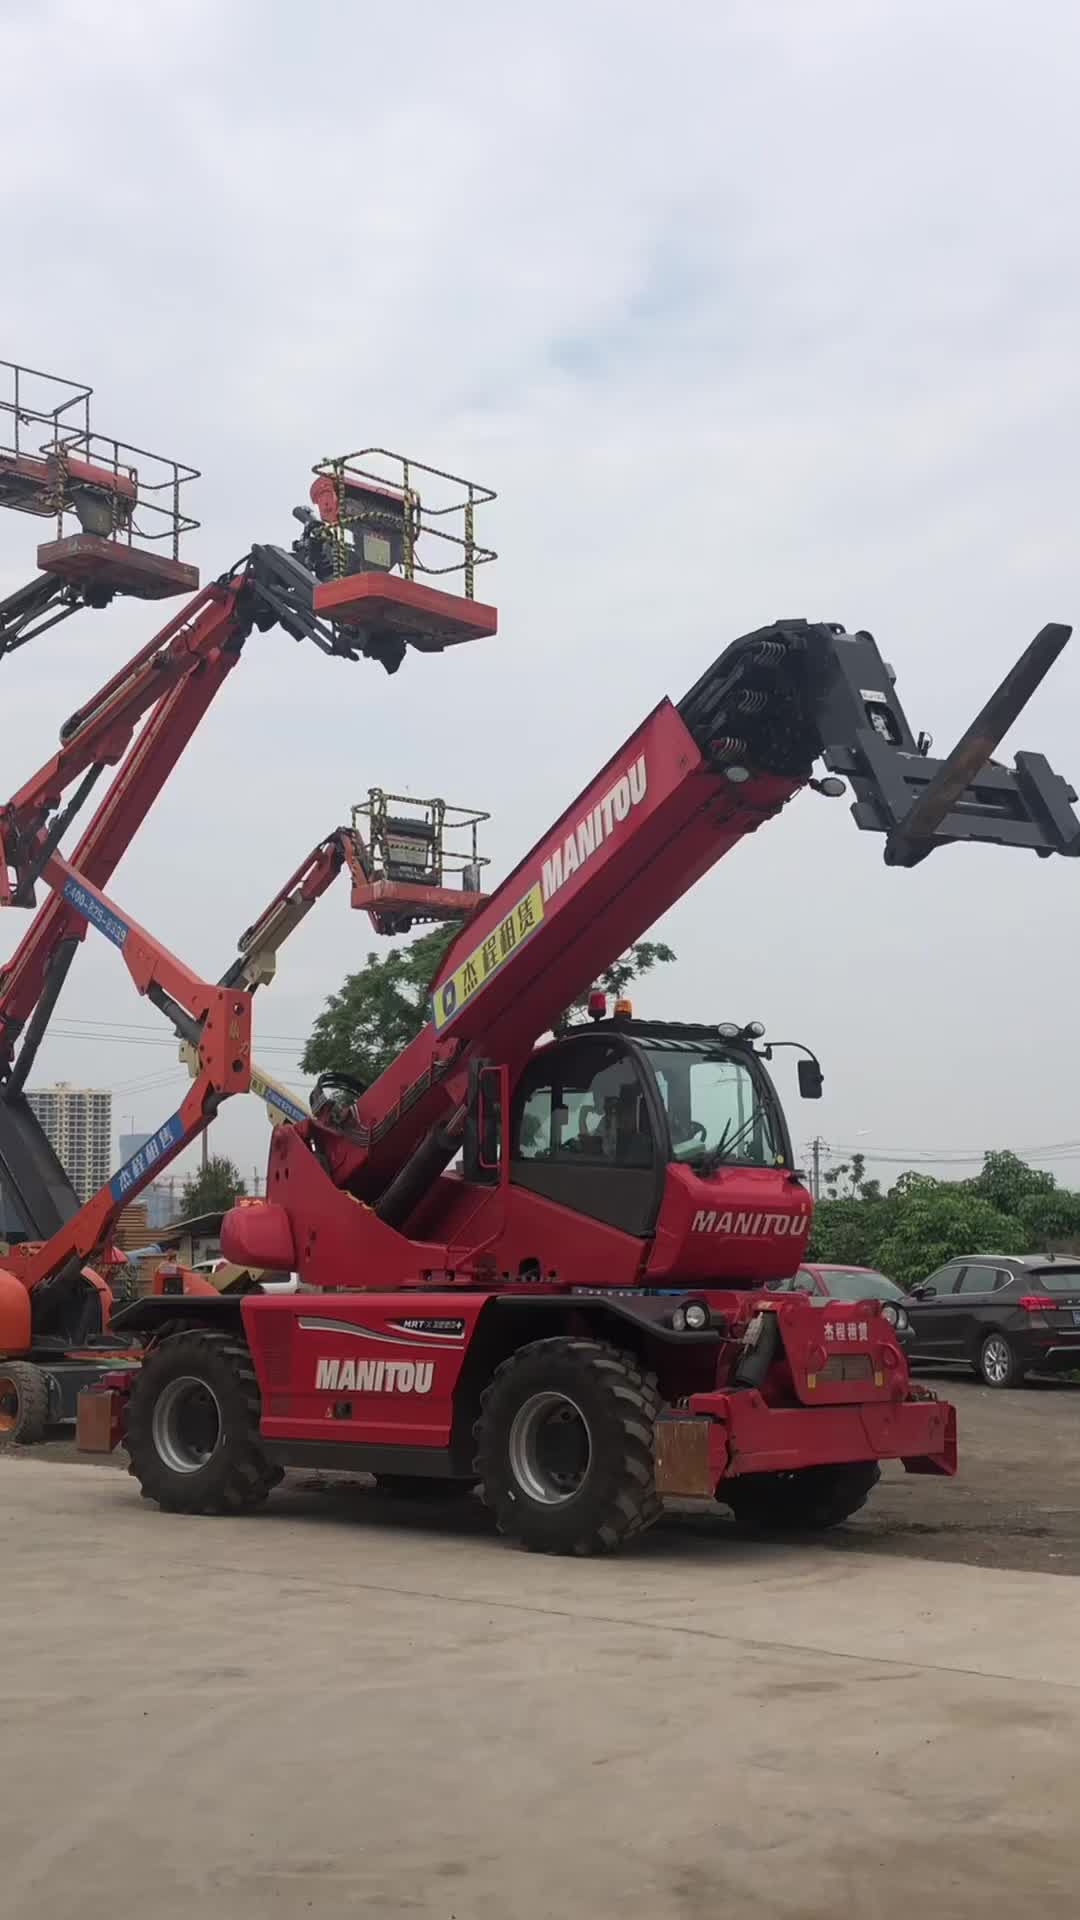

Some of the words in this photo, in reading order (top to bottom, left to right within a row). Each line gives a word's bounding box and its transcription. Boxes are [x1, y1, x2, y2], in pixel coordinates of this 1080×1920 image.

[542, 754, 647, 903] MANITOU
[462, 895, 535, 997] 杰程租赁
[691, 1210, 808, 1236] MANITOU
[823, 1322, 869, 1341] 杰程租赁
[315, 1359, 434, 1393] MANITOU
